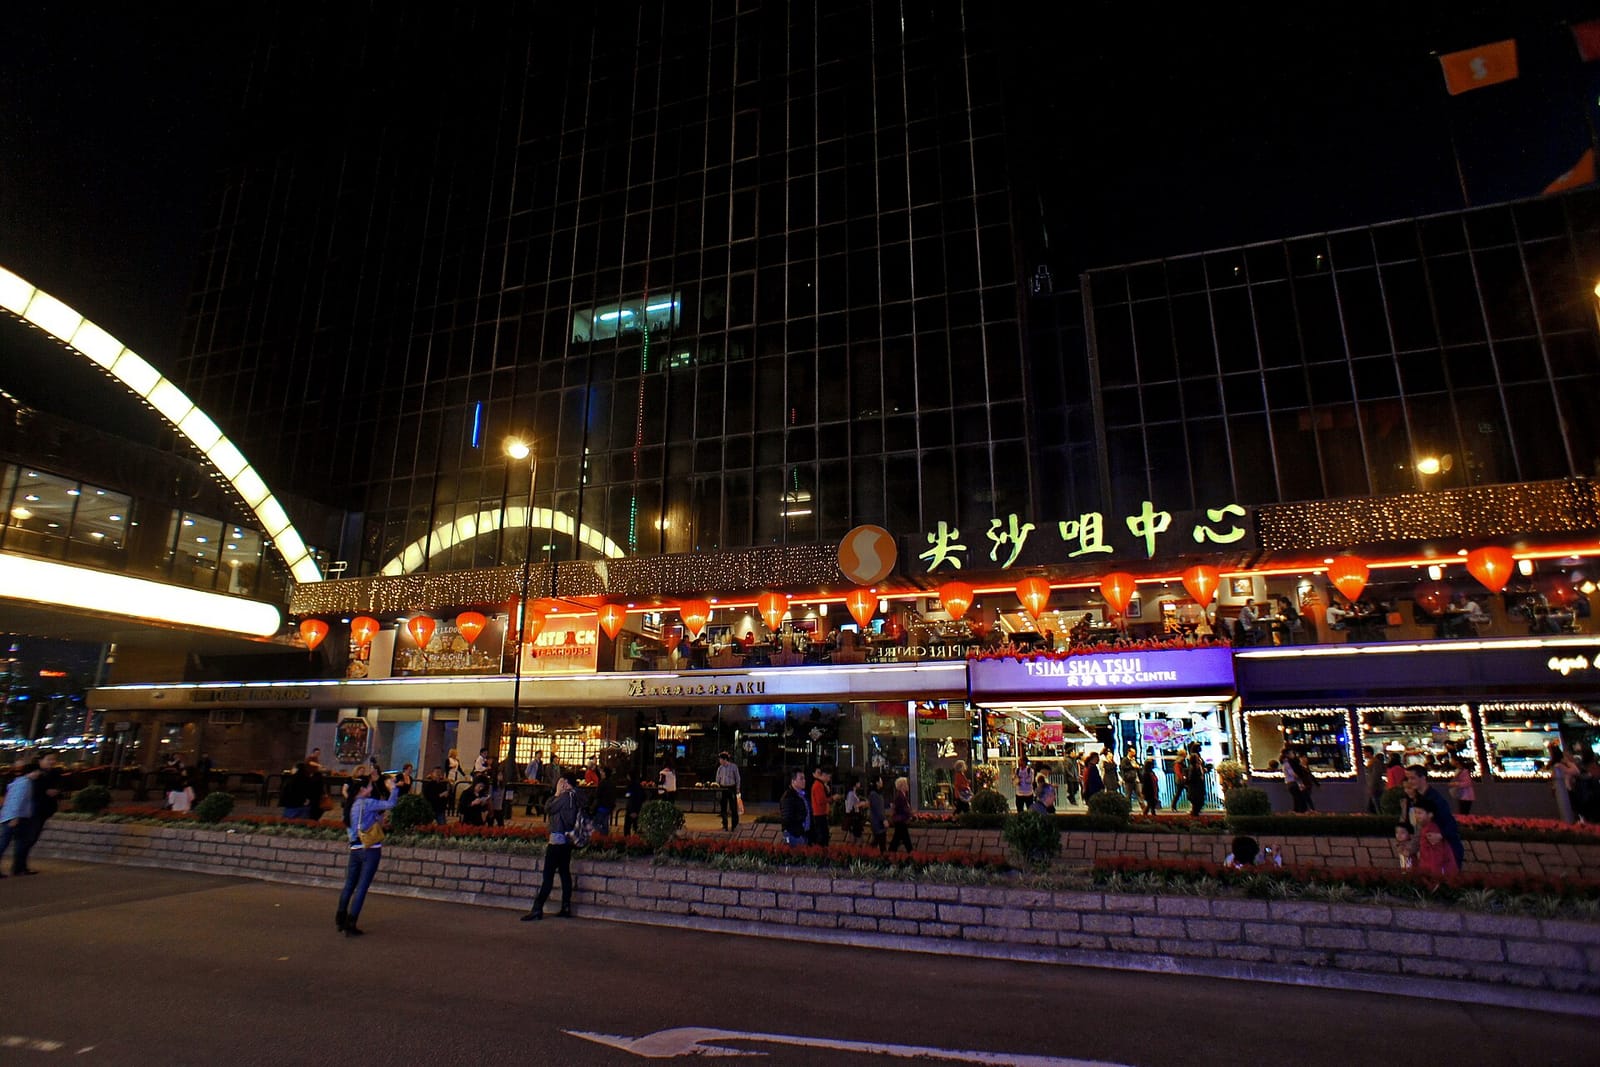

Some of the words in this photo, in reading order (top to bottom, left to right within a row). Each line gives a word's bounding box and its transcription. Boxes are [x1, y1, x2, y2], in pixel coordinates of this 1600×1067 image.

[919, 500, 1246, 573] 尖沙咀中心
[535, 630, 596, 646] UTBACK
[1025, 661, 1064, 675] TSIM
[1069, 659, 1101, 674] SHA
[1103, 658, 1141, 672] TSUI
[1135, 670, 1177, 682] CENTRE
[735, 681, 766, 694] AKU
